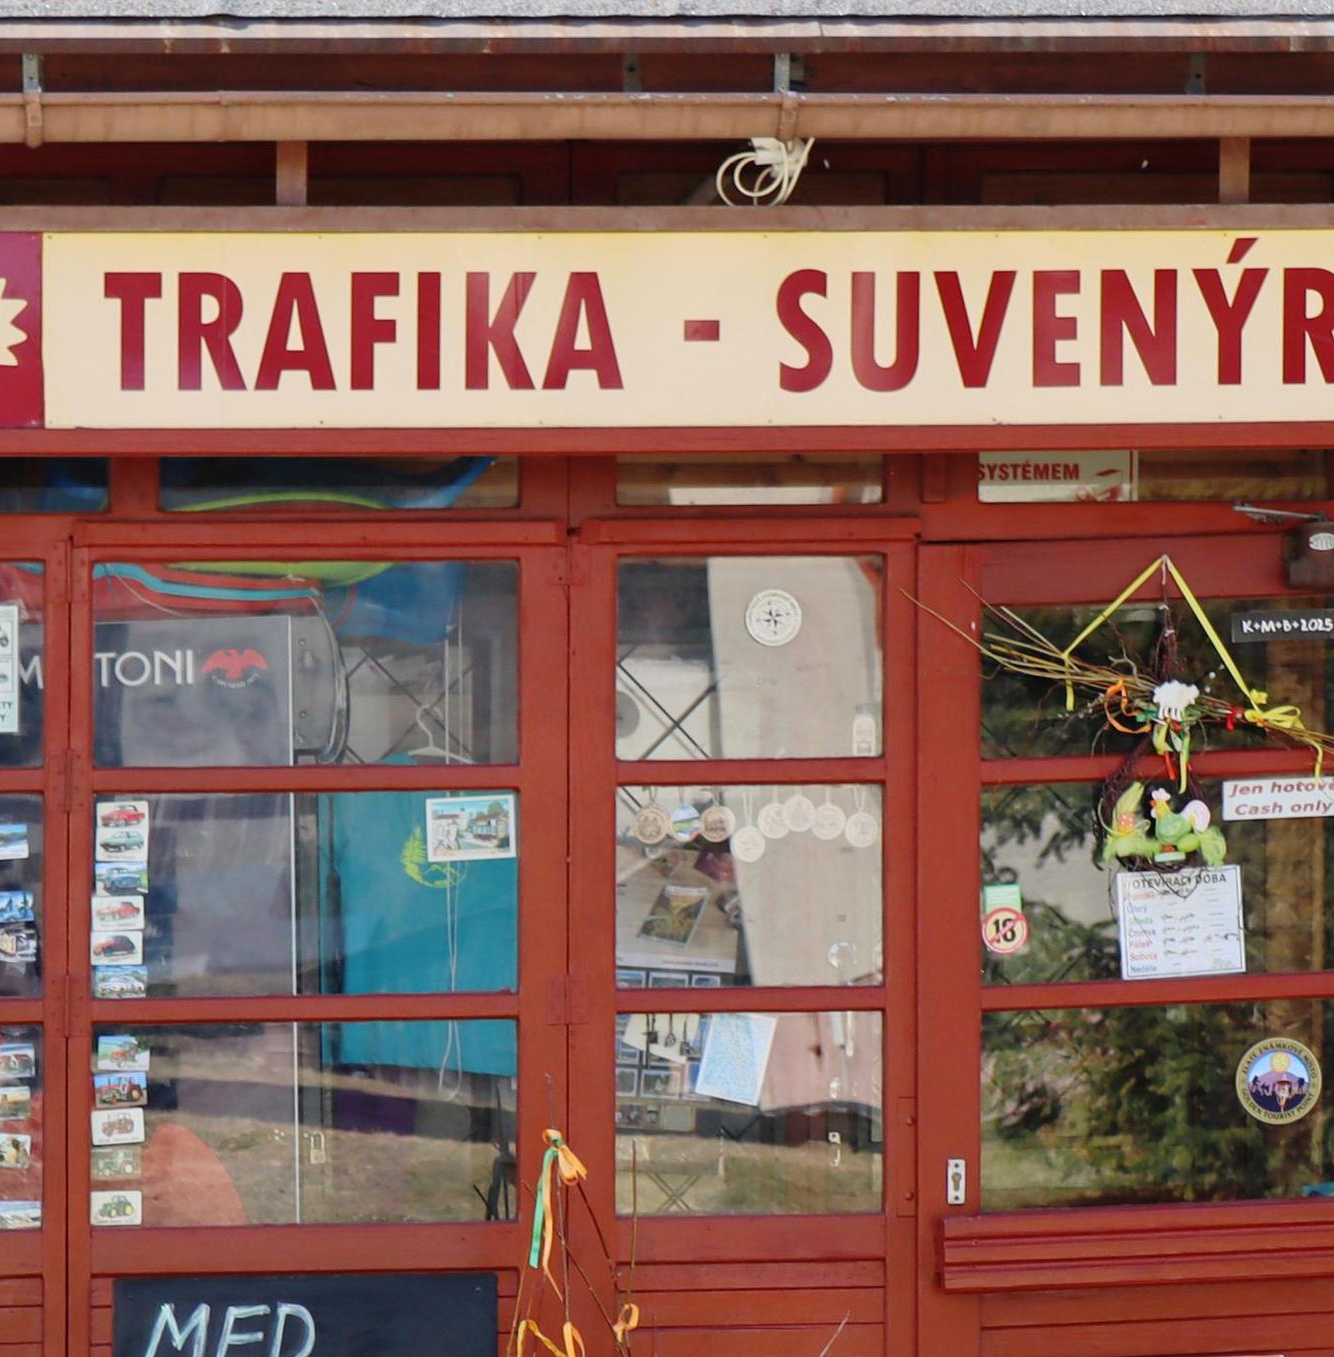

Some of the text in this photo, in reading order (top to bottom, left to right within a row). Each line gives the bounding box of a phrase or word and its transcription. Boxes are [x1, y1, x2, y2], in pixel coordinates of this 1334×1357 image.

[104, 271, 624, 391] TRAFIKA
[683, 319, 720, 342] -
[978, 458, 1080, 482] SYSTÉMEM
[1229, 784, 1263, 798] Jen
[1235, 800, 1334, 816] Cash only
